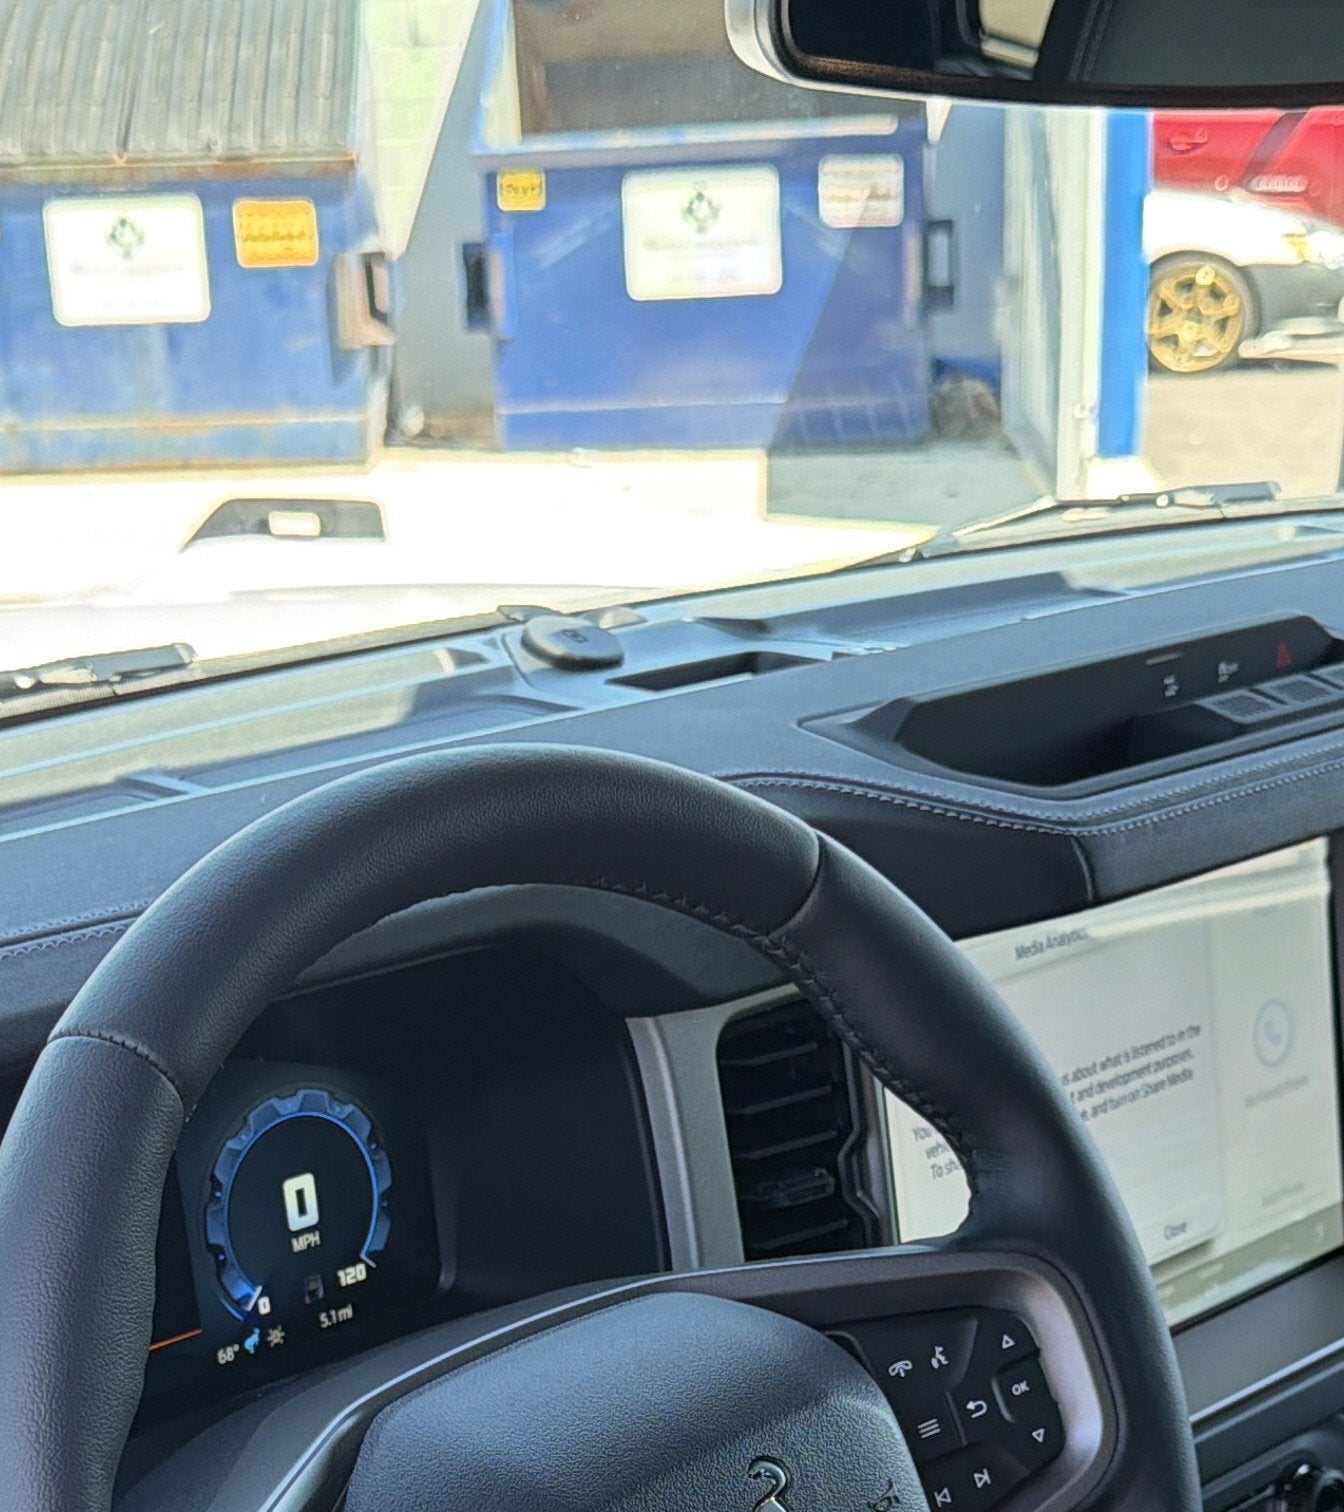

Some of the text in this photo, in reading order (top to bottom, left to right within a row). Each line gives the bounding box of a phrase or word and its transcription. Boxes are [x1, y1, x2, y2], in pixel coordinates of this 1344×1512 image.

[282, 1172, 320, 1232] 0
[290, 1230, 321, 1253] MPH
[337, 1262, 367, 1287] 120
[1011, 1380, 1031, 1396] OK
